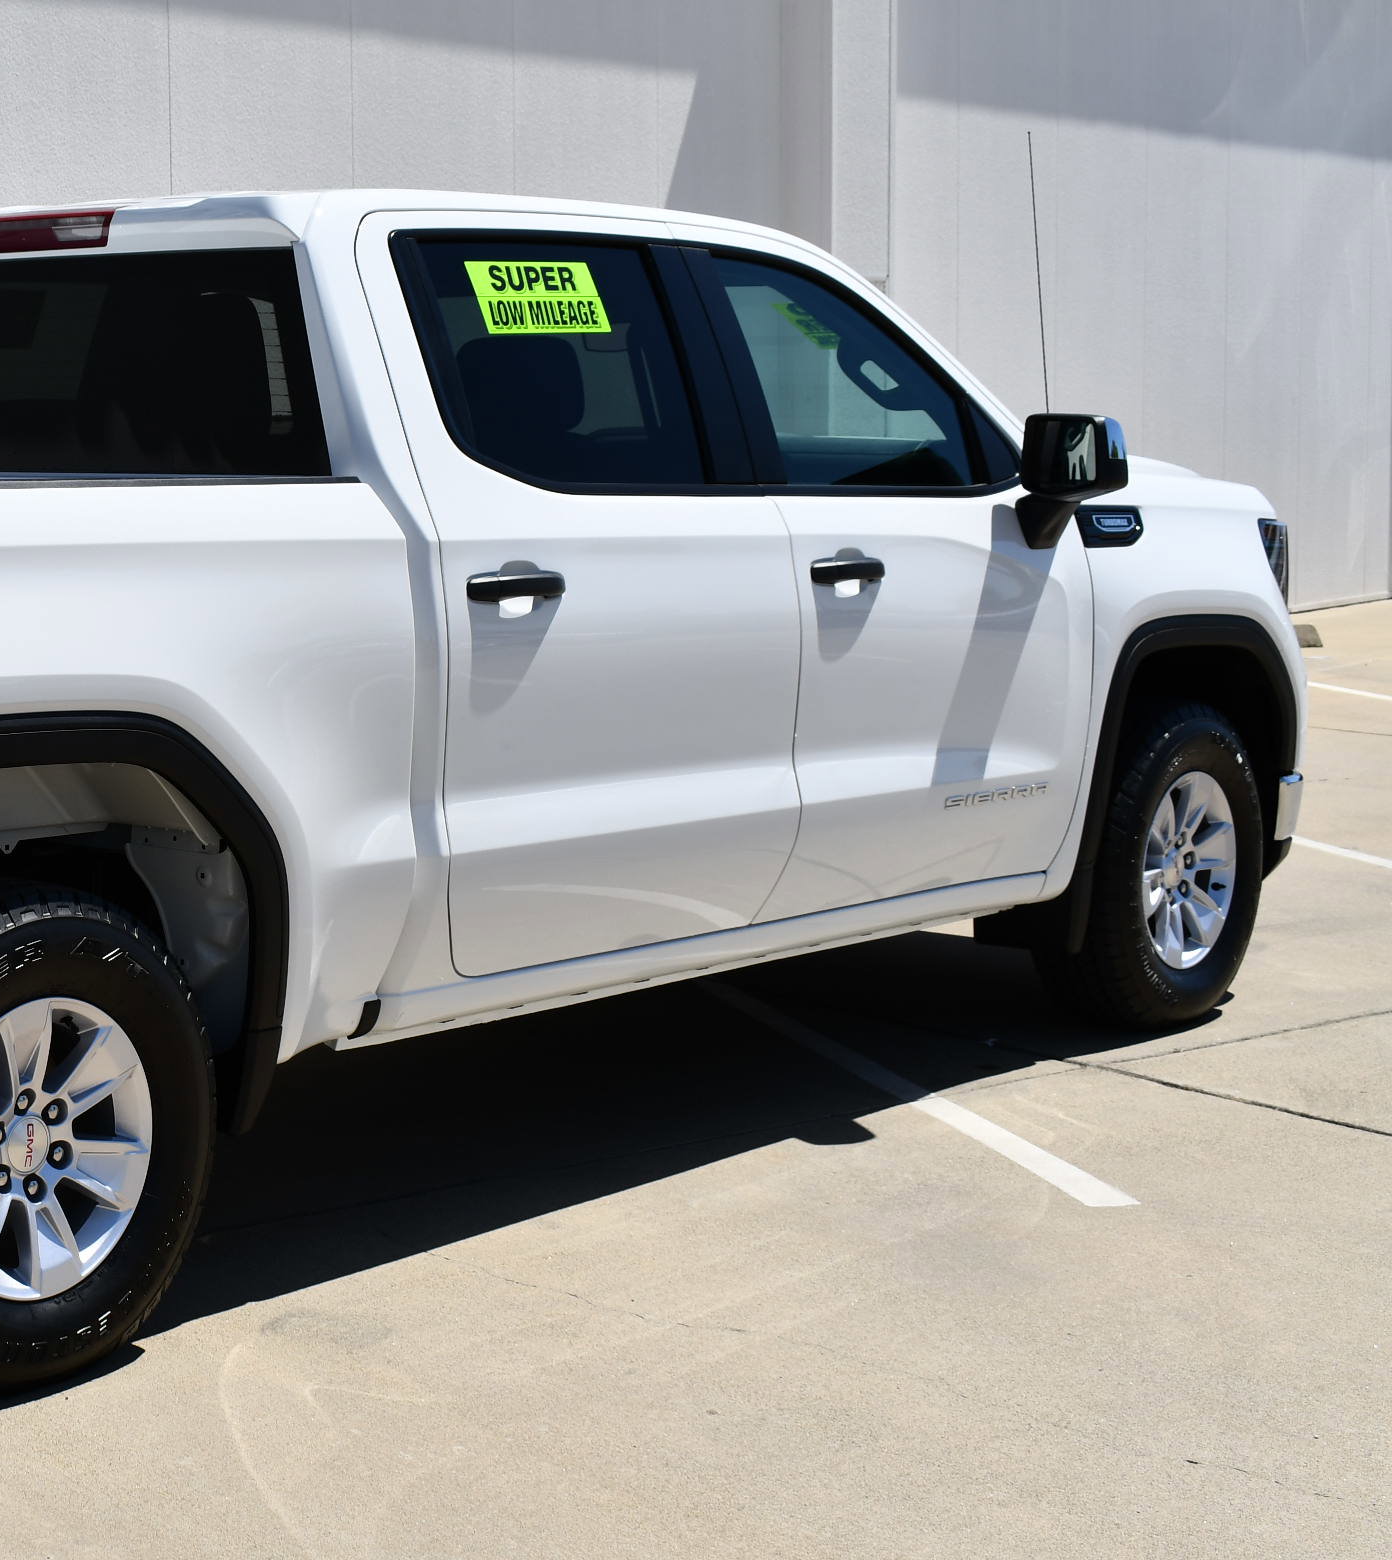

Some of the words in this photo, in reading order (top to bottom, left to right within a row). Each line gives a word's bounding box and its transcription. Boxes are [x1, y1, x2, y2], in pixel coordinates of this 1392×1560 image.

[488, 265, 578, 293] SUPER
[488, 300, 526, 328] LOW
[527, 300, 600, 328] MILEAGE
[944, 782, 1049, 810] SIERRA
[24, 1123, 35, 1168] GMC
